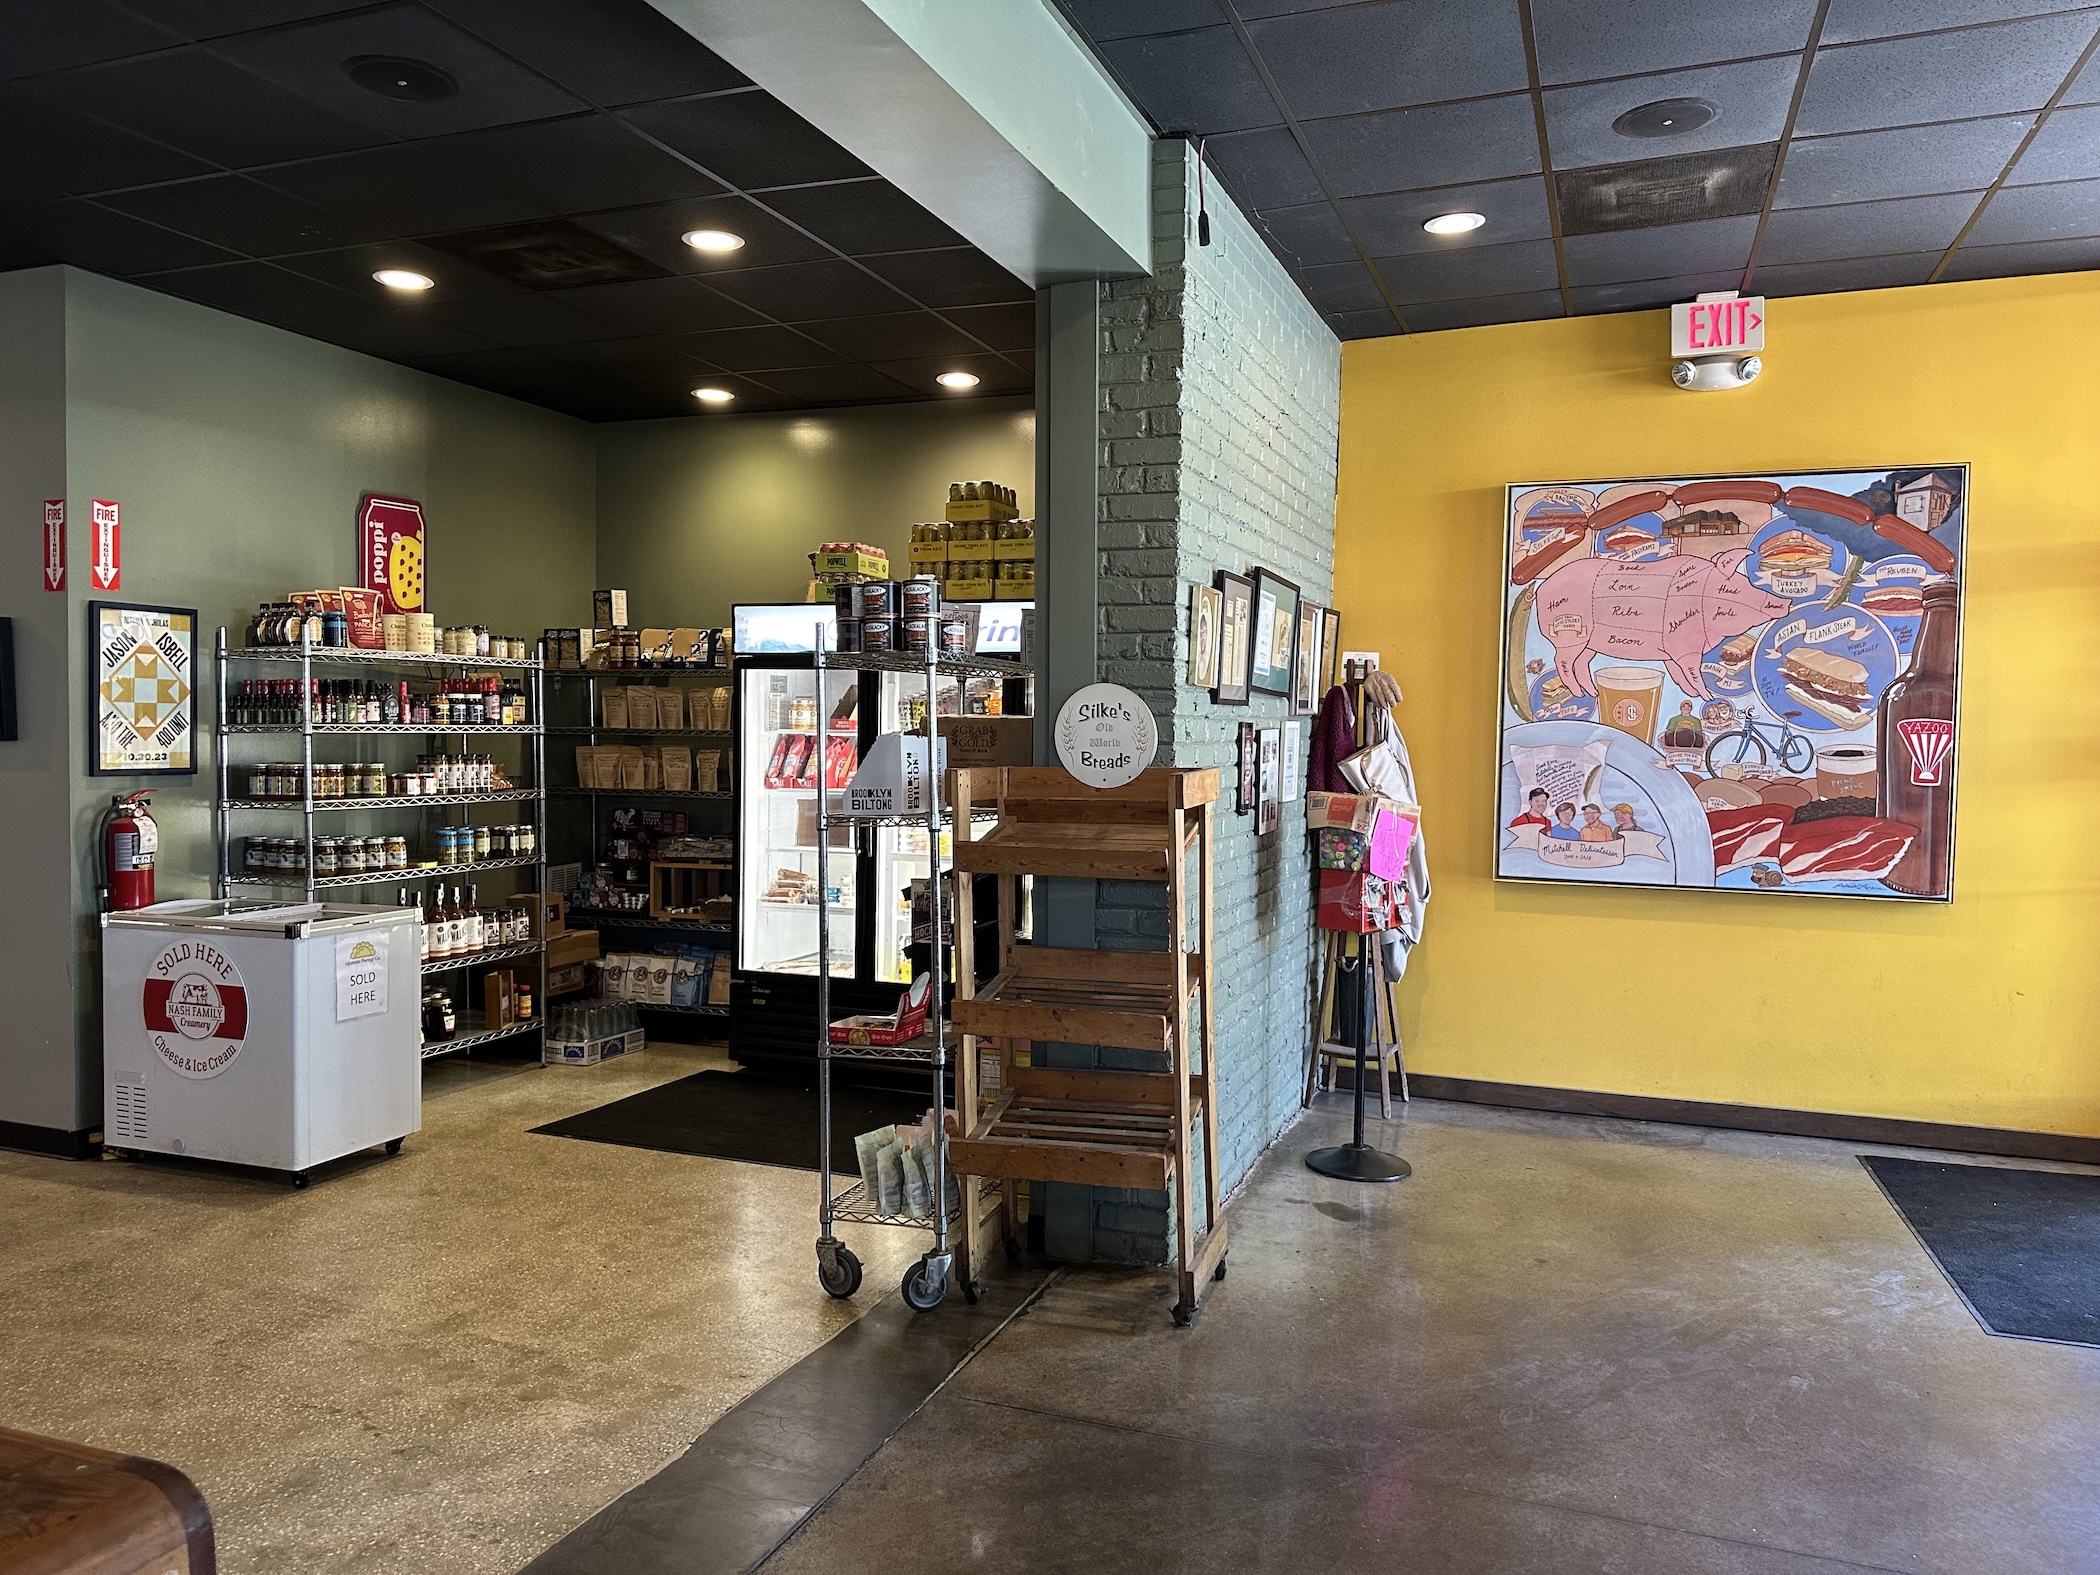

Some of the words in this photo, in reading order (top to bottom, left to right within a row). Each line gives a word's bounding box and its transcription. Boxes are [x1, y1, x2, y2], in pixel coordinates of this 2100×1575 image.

[1688, 301, 1750, 348] EXIT
[47, 508, 62, 520] FIRE
[96, 508, 116, 522] FIRE
[369, 521, 388, 584] poppi
[1631, 543, 1655, 557] PASTRAMI
[1721, 557, 1734, 568] Ear
[1887, 566, 1918, 576] REUBEN
[1608, 579, 1640, 591] Loin
[1717, 584, 1741, 594] Head
[1777, 580, 1803, 588] TURKEY
[1780, 586, 1808, 594] AVOCADO
[1547, 597, 1569, 612] Ham
[1612, 605, 1642, 617] Ribs
[1712, 606, 1737, 621] Jowls
[1668, 608, 1700, 634] Shoulder
[1777, 622, 1801, 643] ASIAN
[1809, 627, 1833, 642] FLANK
[1833, 619, 1852, 633] STEAK
[1607, 634, 1645, 646] Bacon
[1847, 641, 1867, 651] WORLD
[102, 629, 138, 668] JASON
[155, 632, 189, 672] ISBELL
[1852, 643, 1879, 657] FAMOUS!
[1703, 664, 1722, 674] BANH
[1722, 679, 1732, 687] MI
[1078, 702, 1131, 722] Silke's
[156, 727, 176, 749] 400
[167, 711, 189, 736] UNIT
[960, 725, 989, 735] GRAB
[1095, 722, 1113, 732] Old
[1903, 722, 1949, 734] YAZOO
[116, 726, 138, 750] THE
[959, 738, 989, 748] GOLD
[1089, 738, 1120, 747] World
[1081, 751, 1131, 770] Breads
[851, 788, 892, 798] BROOKLYN
[1839, 781, 1864, 794] BREWS
[851, 798, 892, 811] BILTONG
[1542, 842, 1572, 856] Mitchell
[1579, 843, 1619, 858] Delicatessen
[157, 943, 191, 977] SOLD
[195, 943, 233, 979] HERE
[350, 971, 376, 987] SOLD
[350, 990, 376, 1006] HERE
[168, 1004, 191, 1016] NASH
[192, 1005, 223, 1019] FAMILY
[180, 1017, 211, 1031] Creamery
[154, 1035, 187, 1068] Cheese
[185, 1060, 192, 1071] &
[193, 1059, 207, 1072] Ice
[208, 1044, 237, 1070] Cream
